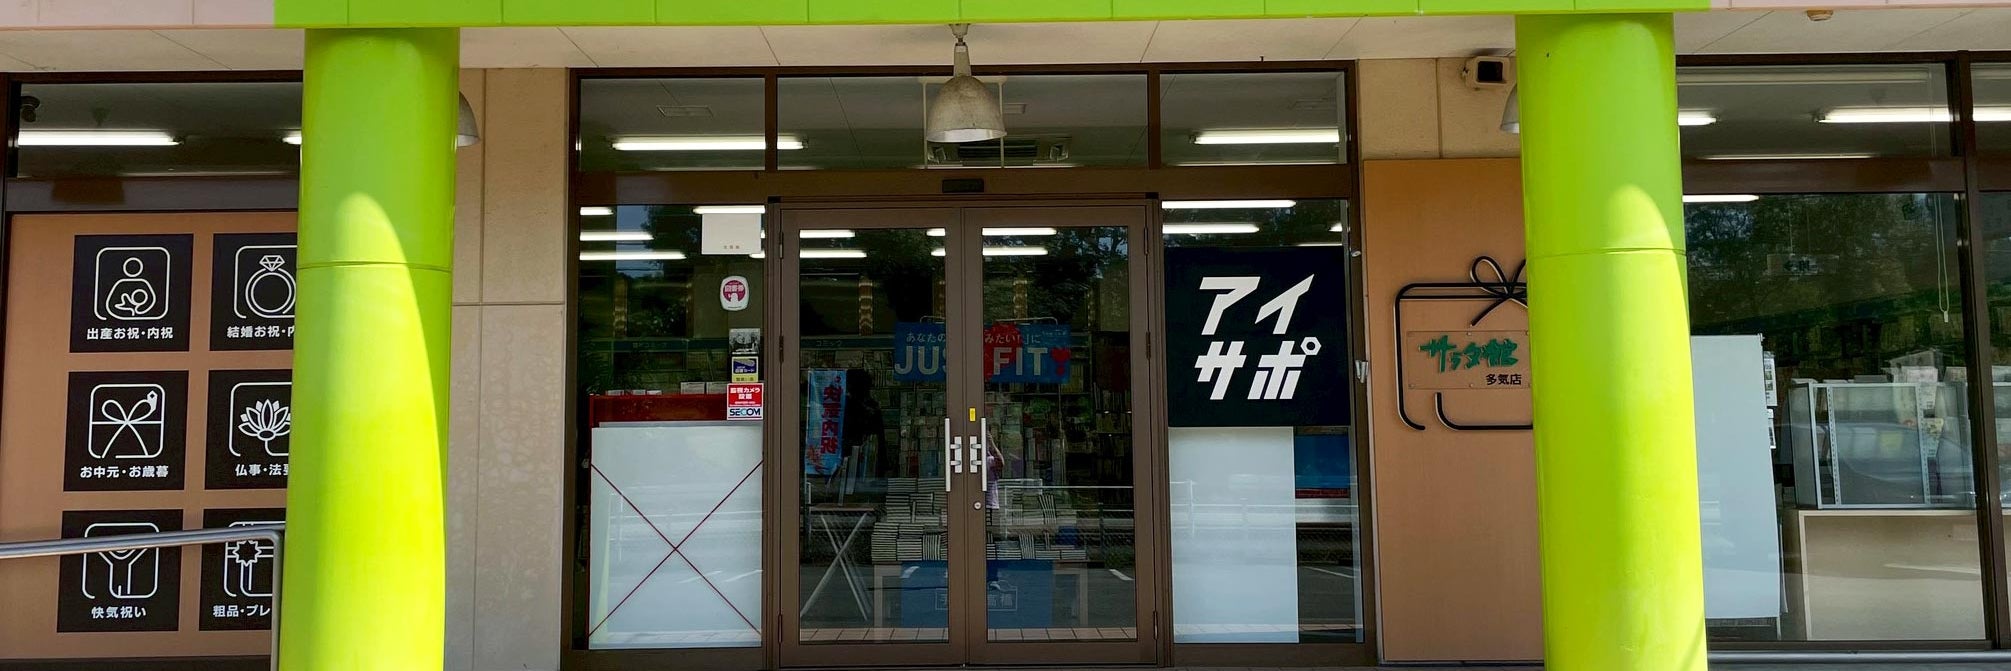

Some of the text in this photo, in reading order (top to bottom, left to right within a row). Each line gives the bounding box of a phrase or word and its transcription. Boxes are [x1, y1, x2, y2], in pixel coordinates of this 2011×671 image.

[1199, 274, 1315, 335] アイ
[86, 327, 174, 340] 出産お祝・内祝
[993, 346, 1048, 376] FIT
[1194, 336, 1322, 400] サポ
[1486, 373, 1522, 385] 多気店
[729, 408, 761, 416] SECOM
[80, 465, 169, 479] お中元・お歳暮
[91, 606, 147, 619] 快気祝い
